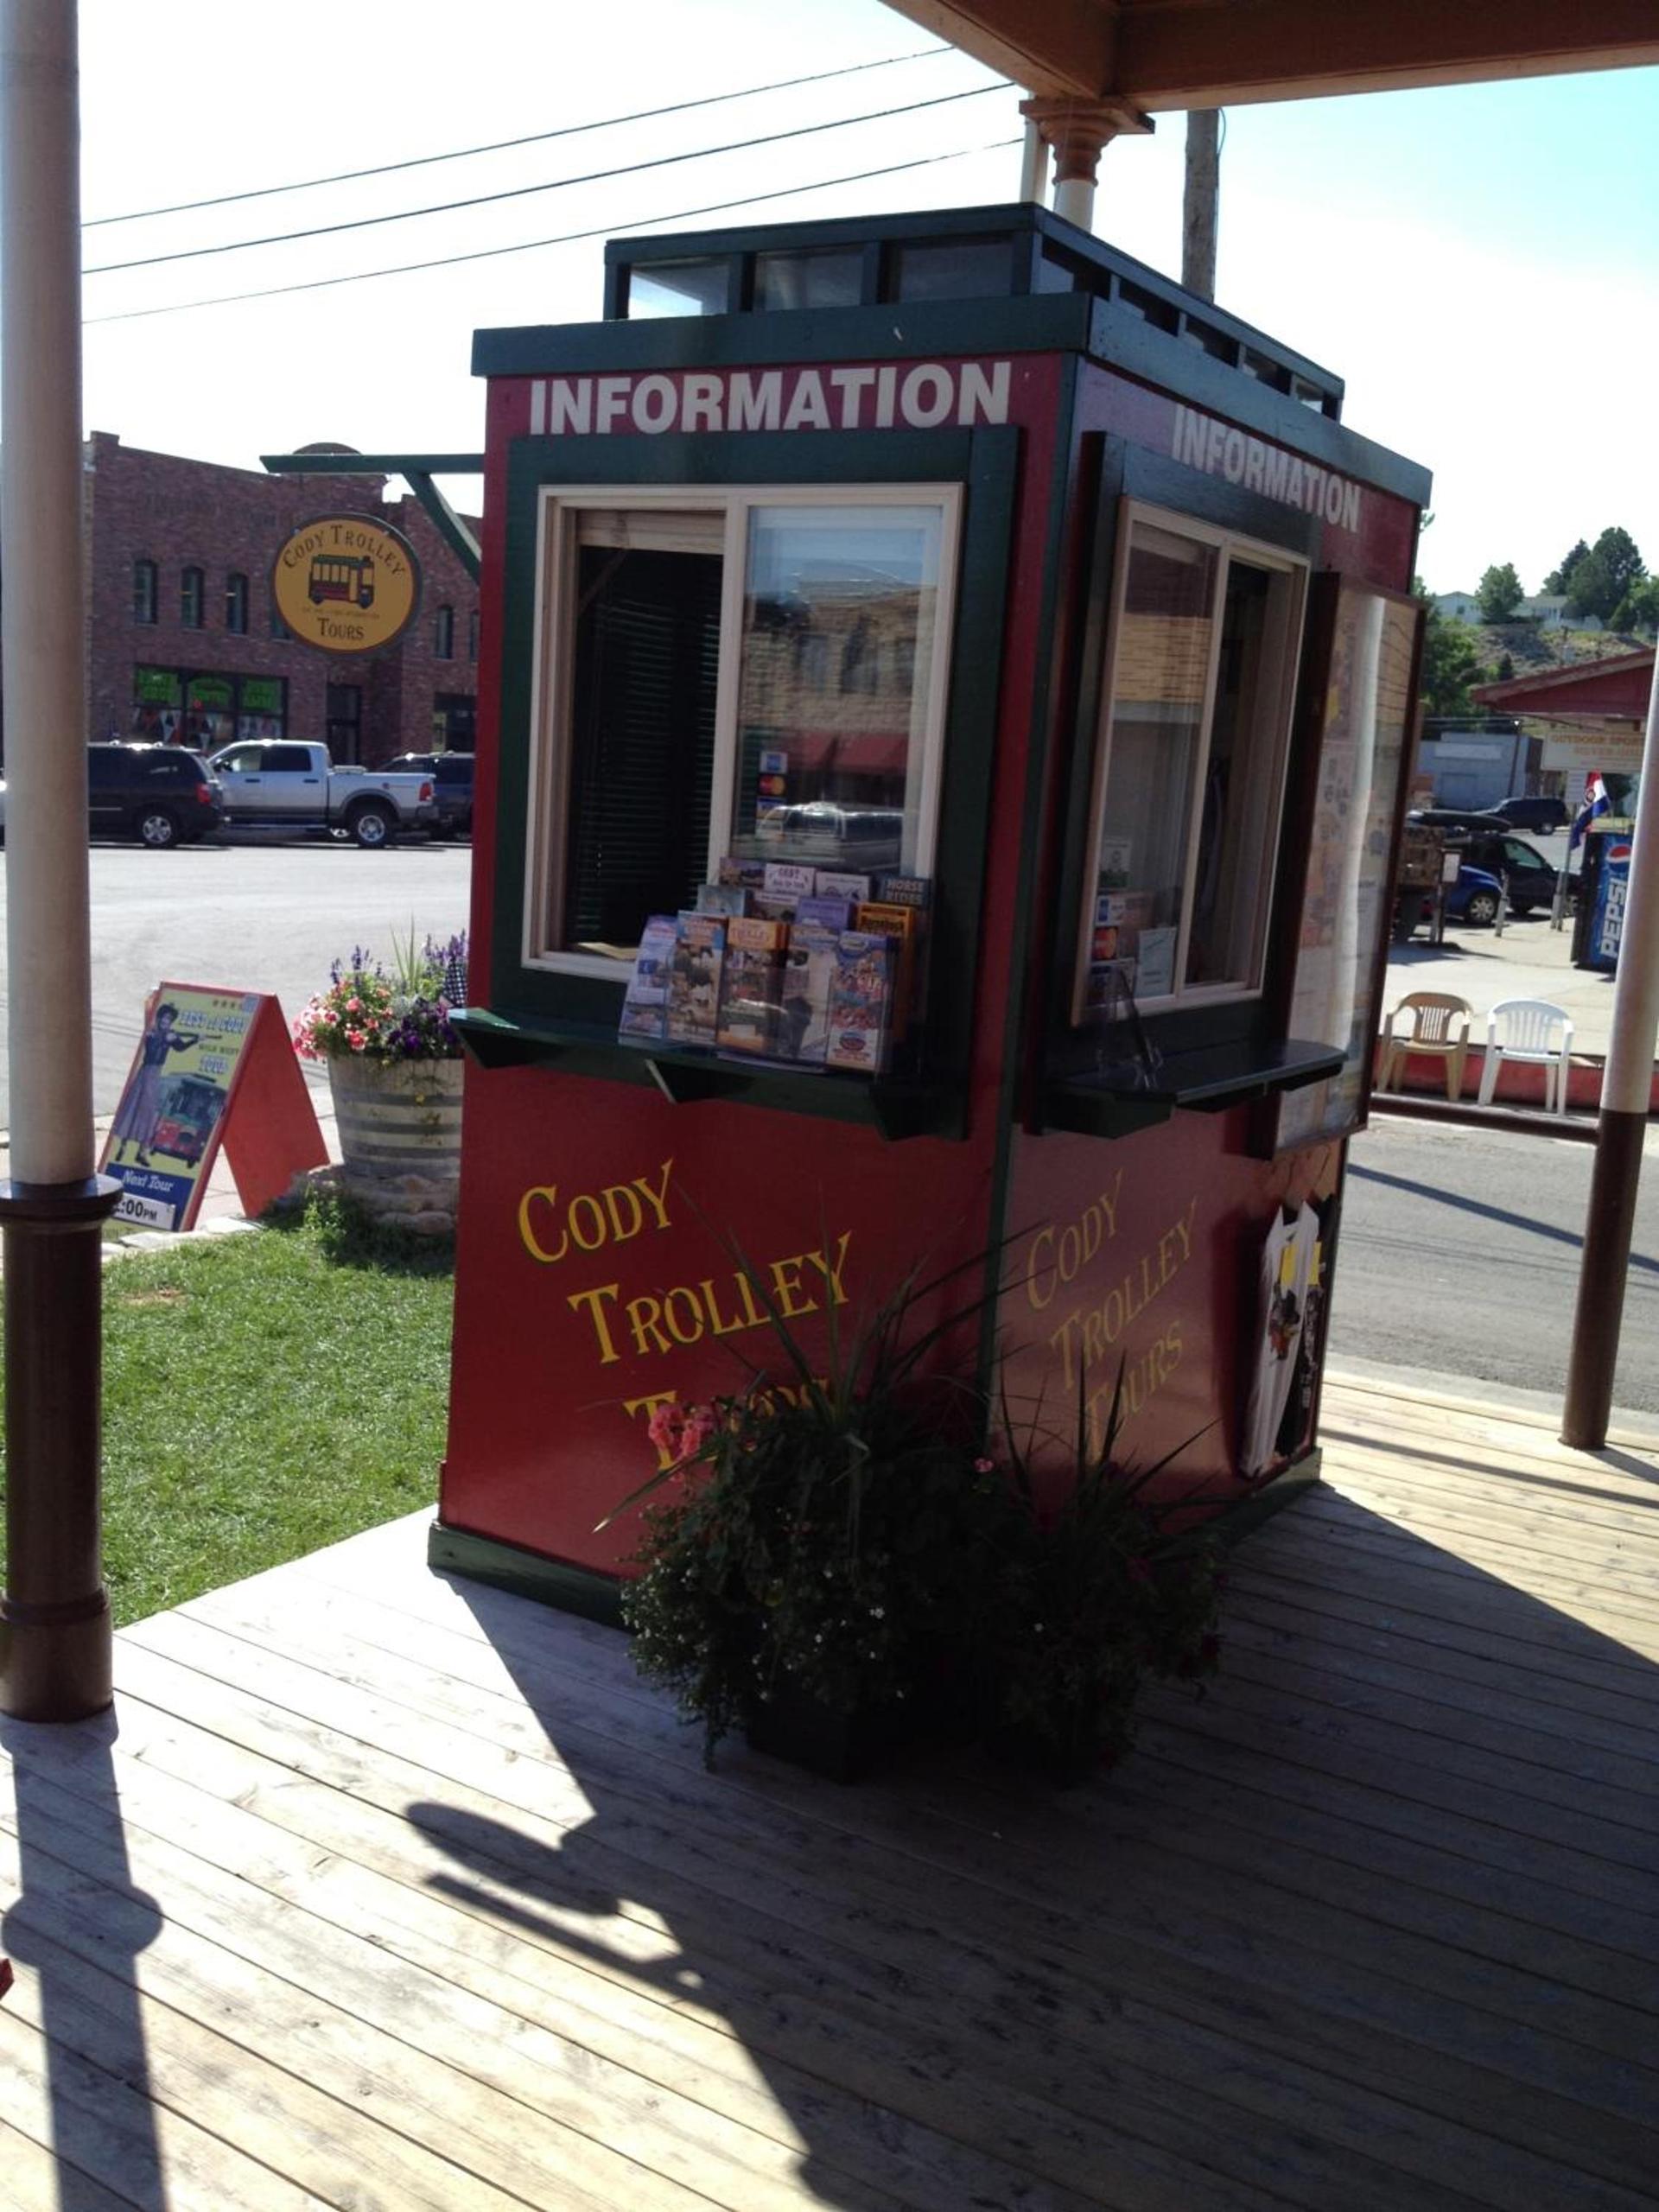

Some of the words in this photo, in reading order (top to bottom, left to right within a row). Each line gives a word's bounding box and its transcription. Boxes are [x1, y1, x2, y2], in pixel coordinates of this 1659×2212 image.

[530, 361, 1012, 435] INFORMATION
[1173, 403, 1361, 533] INFORMATION
[283, 531, 324, 569] CODY
[331, 524, 405, 575] TROLLEY
[317, 617, 364, 640] TOURS
[1600, 877, 1629, 959] PEPSI
[123, 1171, 148, 1187] Next
[148, 1176, 175, 1192] Tour
[518, 1158, 673, 1263] CODY
[1027, 1168, 1122, 1310] CODY
[567, 1230, 852, 1364] TROLLEY
[1051, 1195, 1196, 1390] TROLLEY
